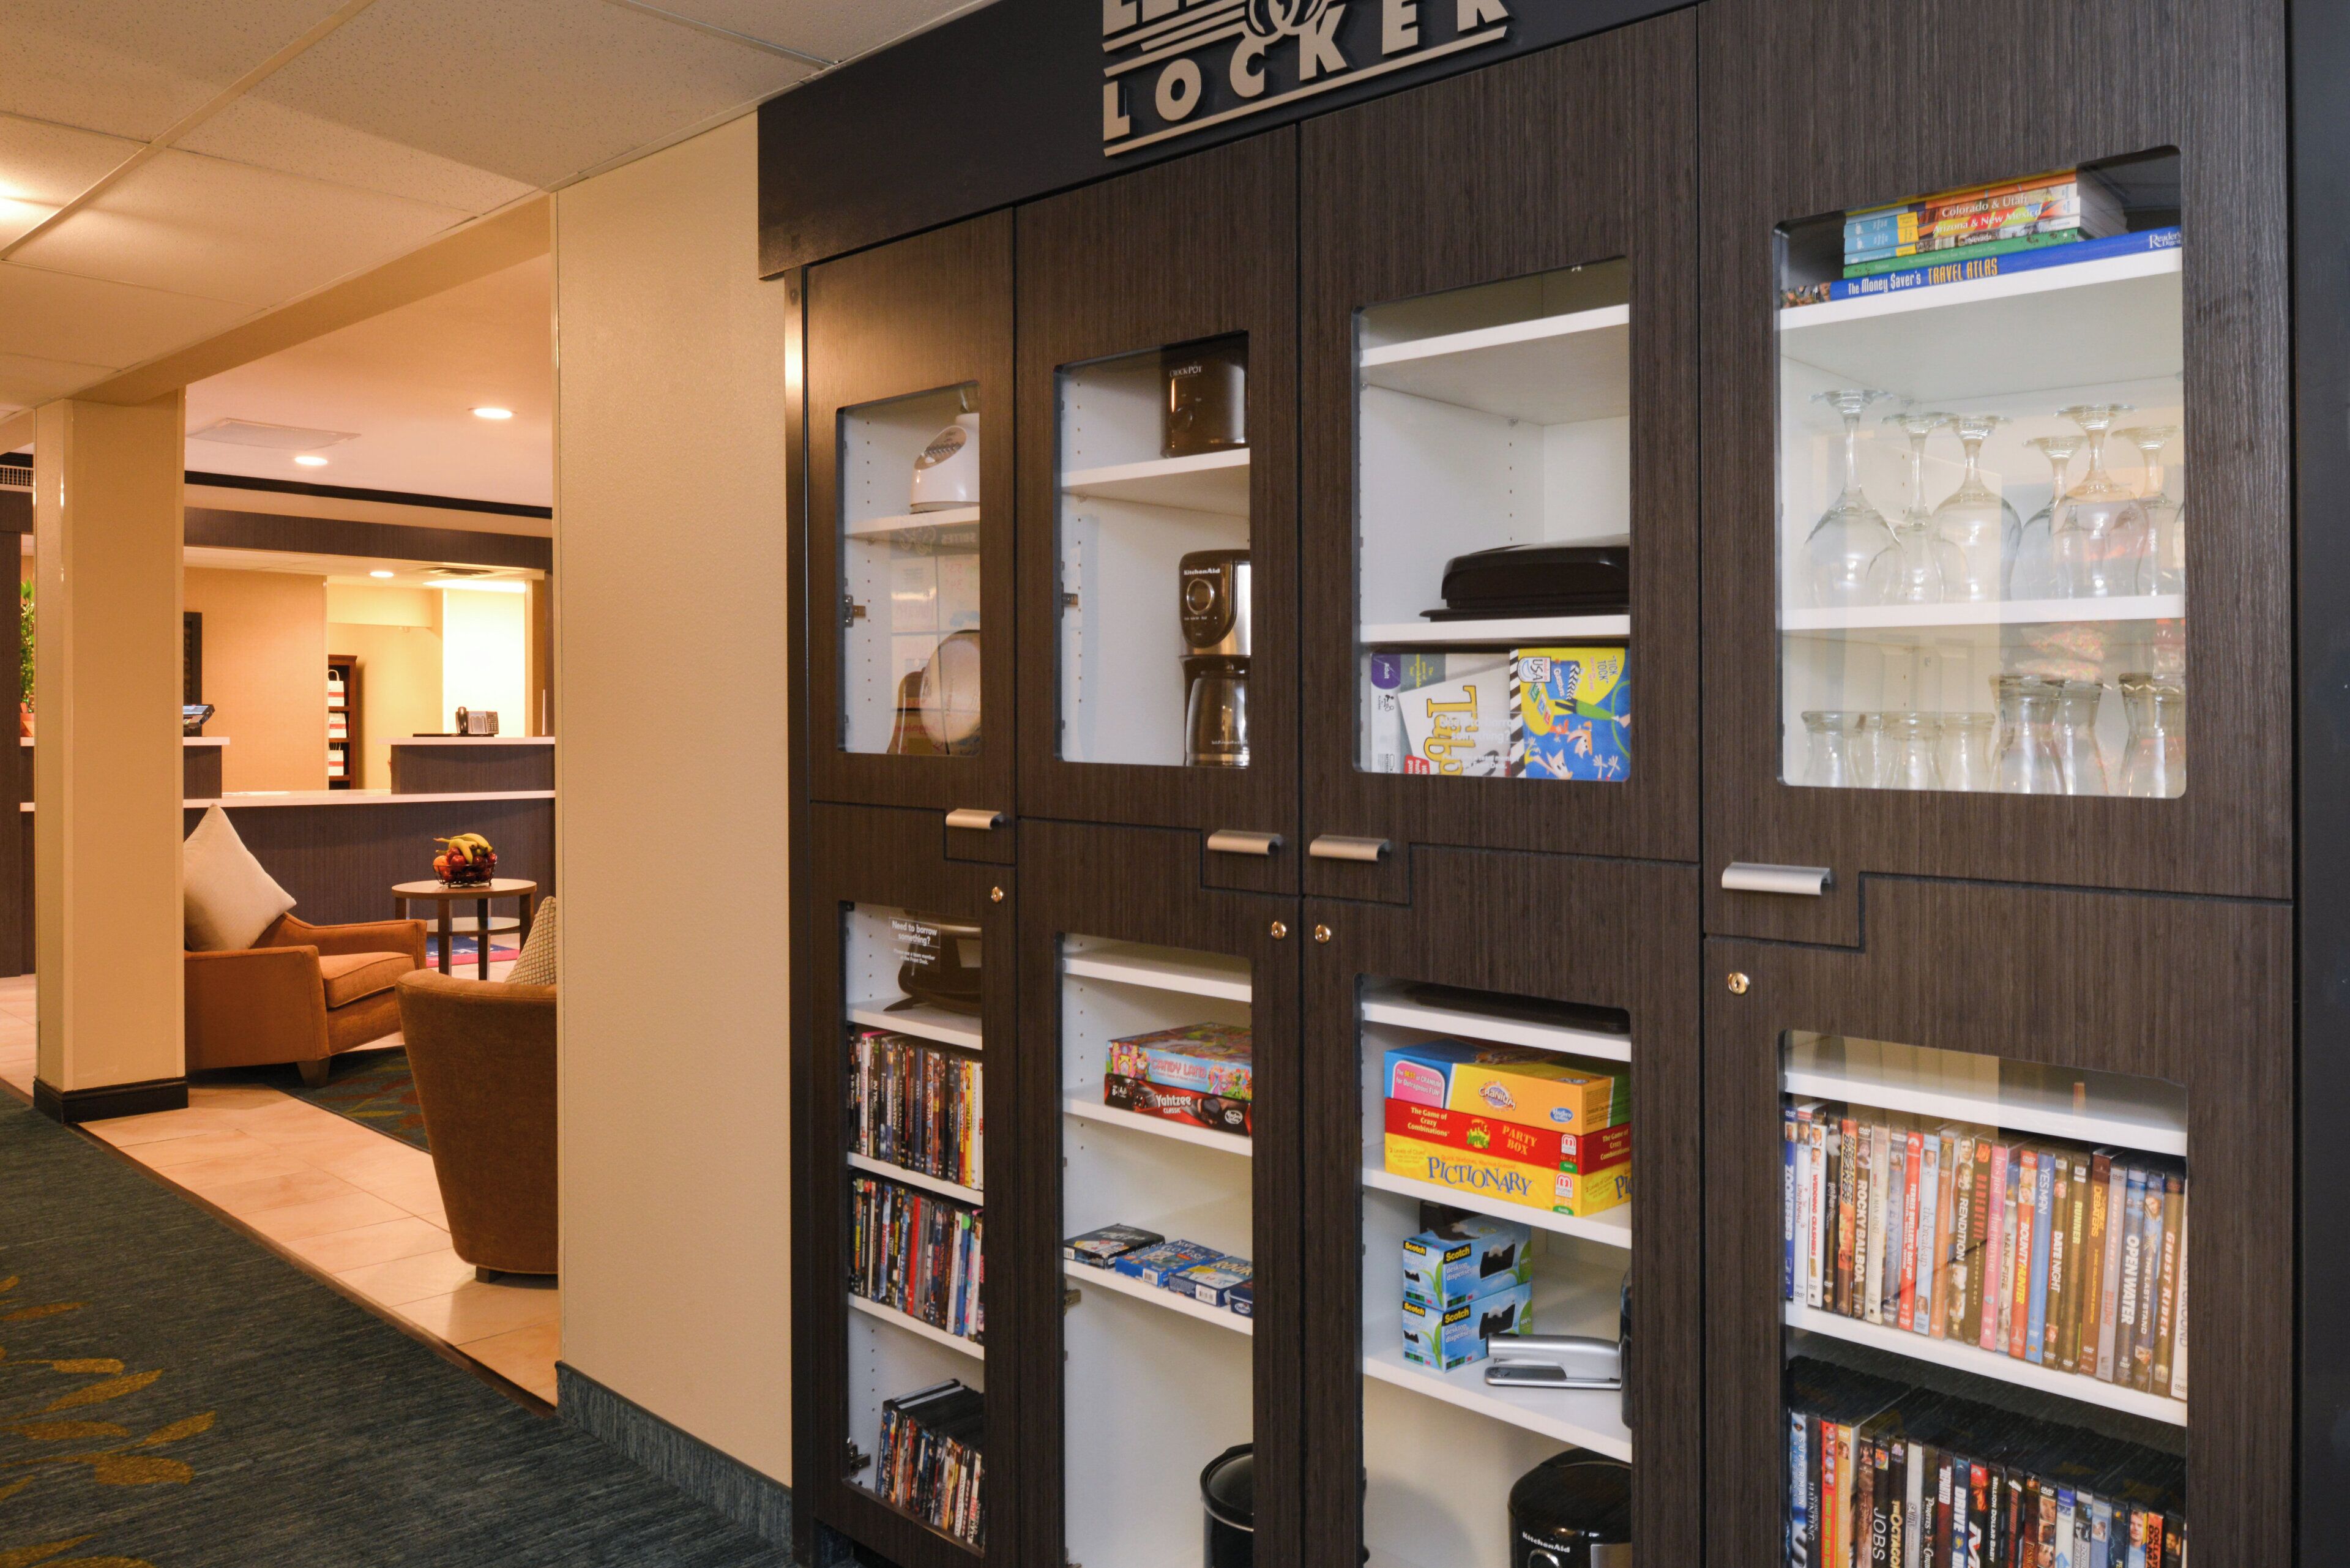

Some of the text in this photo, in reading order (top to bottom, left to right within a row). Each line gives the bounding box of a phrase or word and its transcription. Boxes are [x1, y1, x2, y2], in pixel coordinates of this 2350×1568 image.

[1103, 0, 1510, 141] LOCKER
[1942, 194, 2028, 217] Colorado & Utah
[1933, 209, 2042, 234] Arizona & New Mexico
[1967, 234, 1992, 243] Nevada
[1848, 283, 1859, 295] The
[1861, 278, 1889, 293] Money
[1928, 264, 1963, 285] TRAVEL
[1966, 257, 1998, 280] ATLAS
[1530, 659, 1543, 681] USA
[892, 920, 938, 936] Need to borrow
[898, 933, 931, 947] something?
[1151, 1057, 1182, 1072] CANDY
[1183, 1062, 1207, 1078] LAND
[873, 1080, 878, 1090] IN
[1403, 1080, 1429, 1094] Outrageous
[1404, 1070, 1416, 1080] BEST
[1420, 1076, 1442, 1088] CRANIUM
[1154, 1094, 1192, 1108] Yahtzee
[1410, 1106, 1422, 1116] The
[1422, 1107, 1440, 1119] Game
[1420, 1117, 1437, 1127] Crazy
[1407, 1122, 1449, 1137] Combinations
[1502, 1125, 1538, 1148] PARTY
[1602, 1135, 1611, 1143] The
[1611, 1131, 1623, 1141] Game
[1858, 1127, 1871, 1135] DVD
[1507, 1138, 1529, 1156] BOX
[1427, 1156, 1533, 1197] PICTIONARY
[2037, 1167, 2050, 1215] YES MAN
[1972, 1173, 1988, 1239] DAREDEVIL
[2091, 1185, 2103, 1237] DEBATERS
[1854, 1179, 1867, 1283] ROCKY BALBOA
[1907, 1212, 1915, 1250] BUELLER'S
[1956, 1197, 1969, 1261] RENDITION
[1990, 1213, 2002, 1233] that
[2072, 1200, 2083, 1244] RUNNER
[1919, 1206, 1933, 1267] the break-up
[1404, 1241, 1426, 1255] Scotch
[1445, 1246, 1471, 1261] Scotch
[2108, 1236, 2117, 1272] RIDER
[1446, 1262, 1469, 1274] desktop
[2001, 1231, 2012, 1291] MAN FIRE
[2015, 1221, 2030, 1304] BOUNTY HUNTER
[2051, 1230, 2064, 1293] DATE NIGHT
[1446, 1267, 1473, 1281] dispenser
[2121, 1234, 2140, 1325] OPEN WATER
[2159, 1231, 2176, 1337] GHOST RIDER
[1403, 1302, 1425, 1315] Scotch
[1444, 1308, 1469, 1324] Scotch
[1444, 1329, 1472, 1343] dispenser
[1445, 1323, 1467, 1335] desktop
[2008, 1479, 2022, 1492] 4
[2040, 1485, 2055, 1497] DVD
[1925, 1496, 1934, 1530] PIRATES
[1953, 1485, 1967, 1533] DRIVE
[1522, 1531, 1570, 1553] KitchenAid
[1873, 1507, 1887, 1561] JOBS
